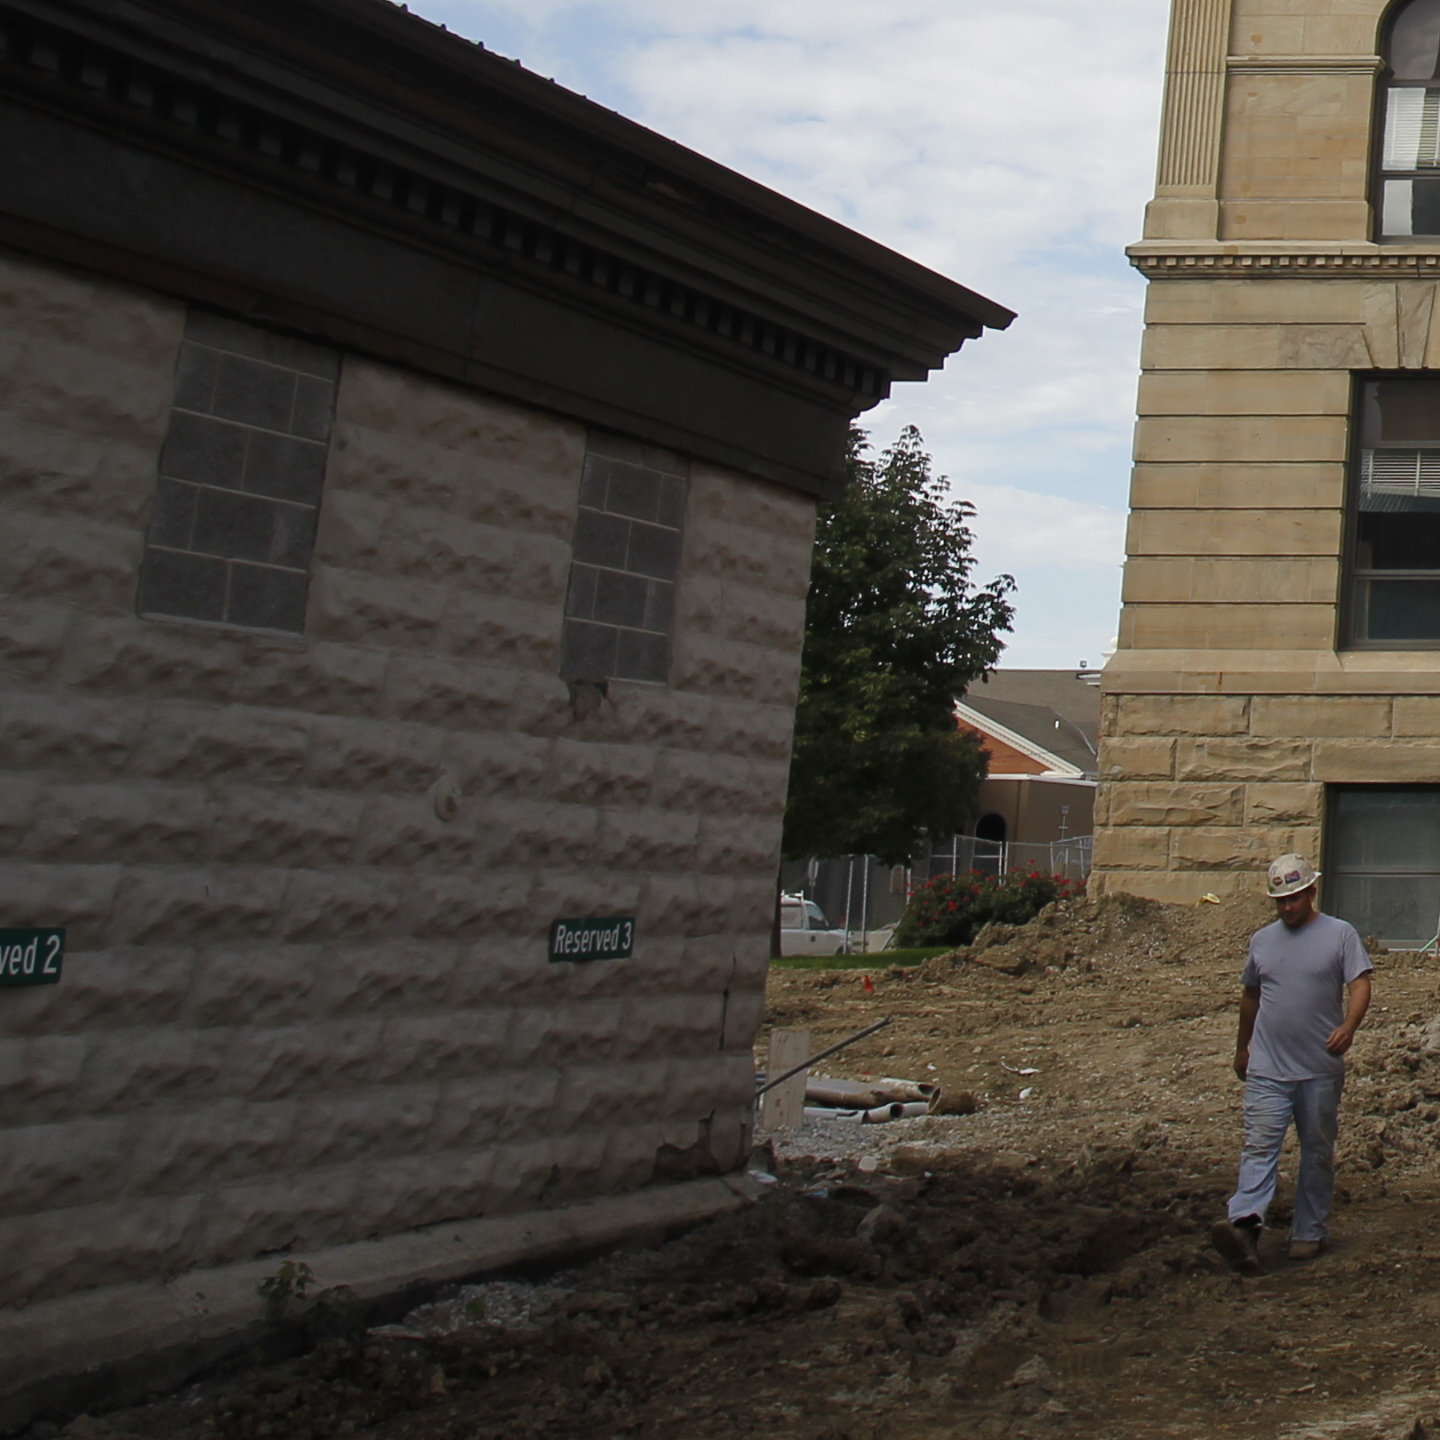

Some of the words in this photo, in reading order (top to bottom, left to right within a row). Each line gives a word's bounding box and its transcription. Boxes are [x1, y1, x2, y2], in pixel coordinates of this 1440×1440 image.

[43, 934, 61, 974] 2
[553, 923, 621, 954] Reserved
[622, 921, 632, 950] 3
